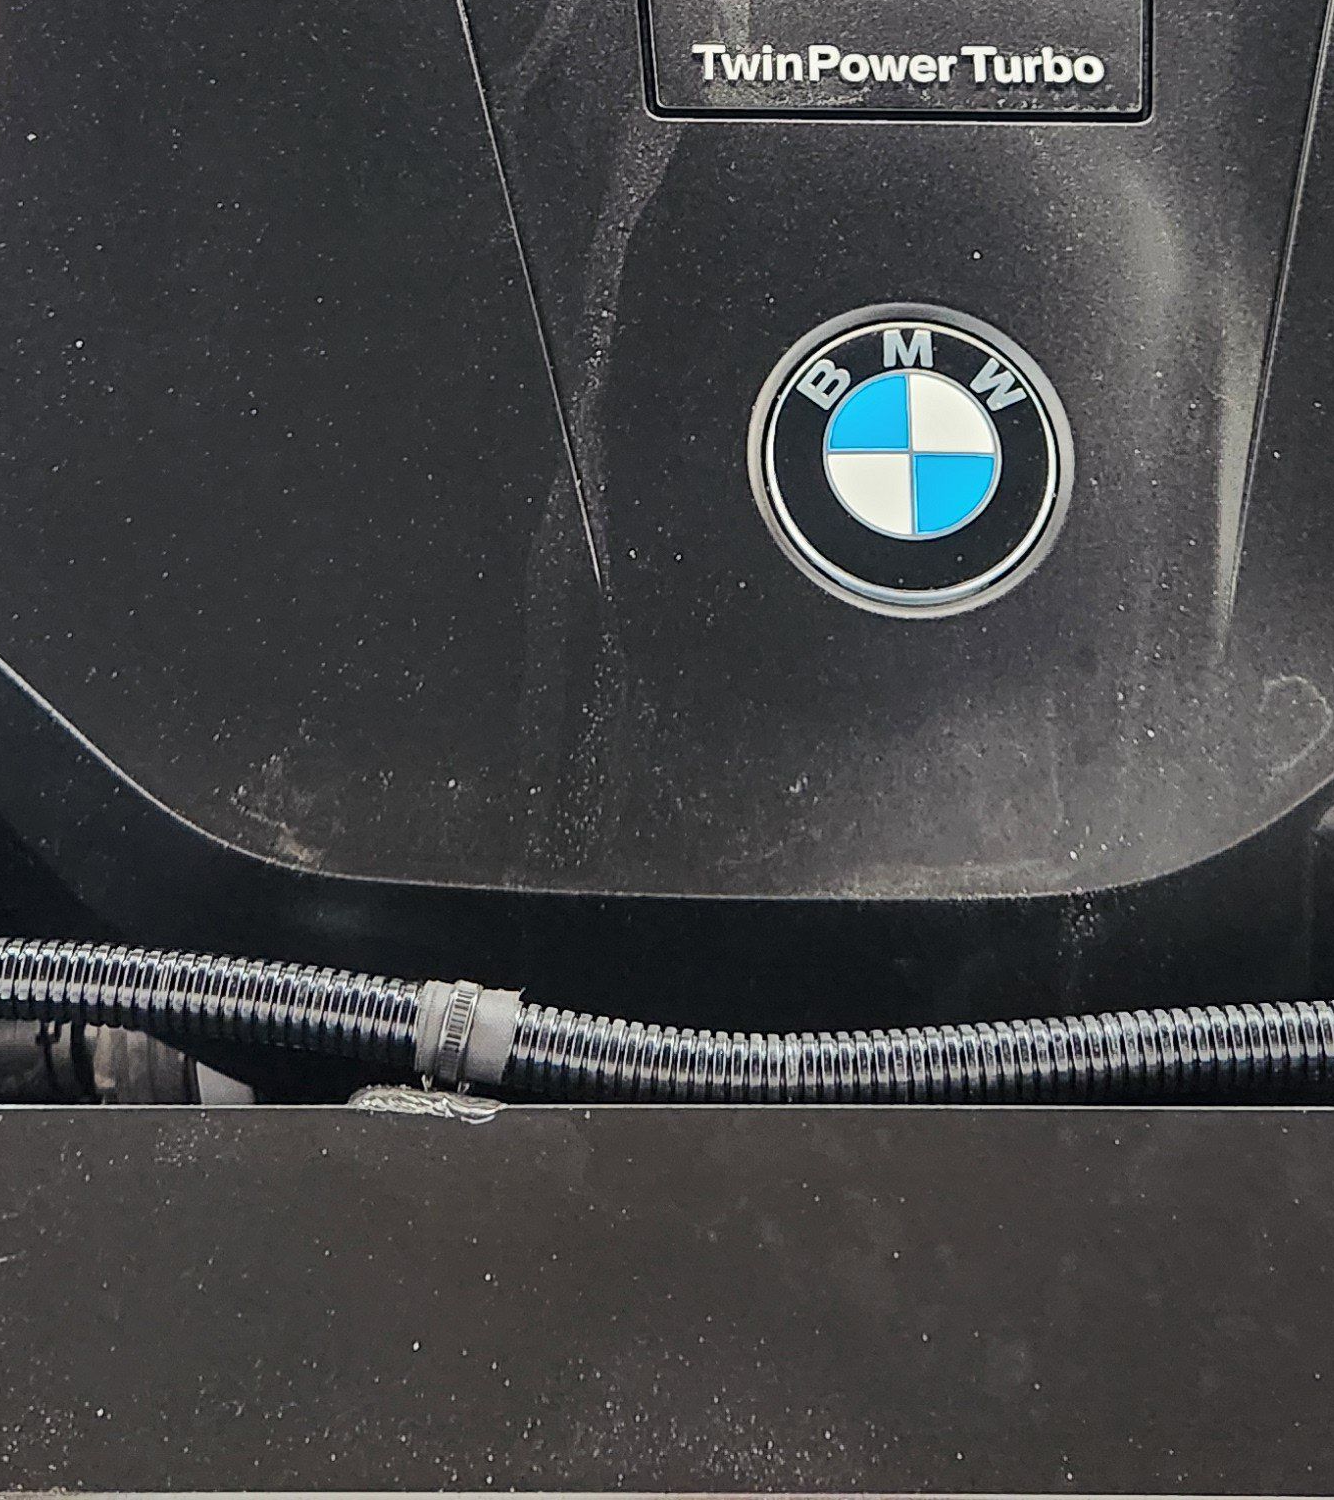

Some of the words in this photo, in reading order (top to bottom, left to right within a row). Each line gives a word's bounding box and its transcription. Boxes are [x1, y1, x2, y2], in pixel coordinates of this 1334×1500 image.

[691, 43, 957, 83] TwinPower
[961, 45, 1105, 85] Turbo
[796, 328, 1027, 411] BMW
